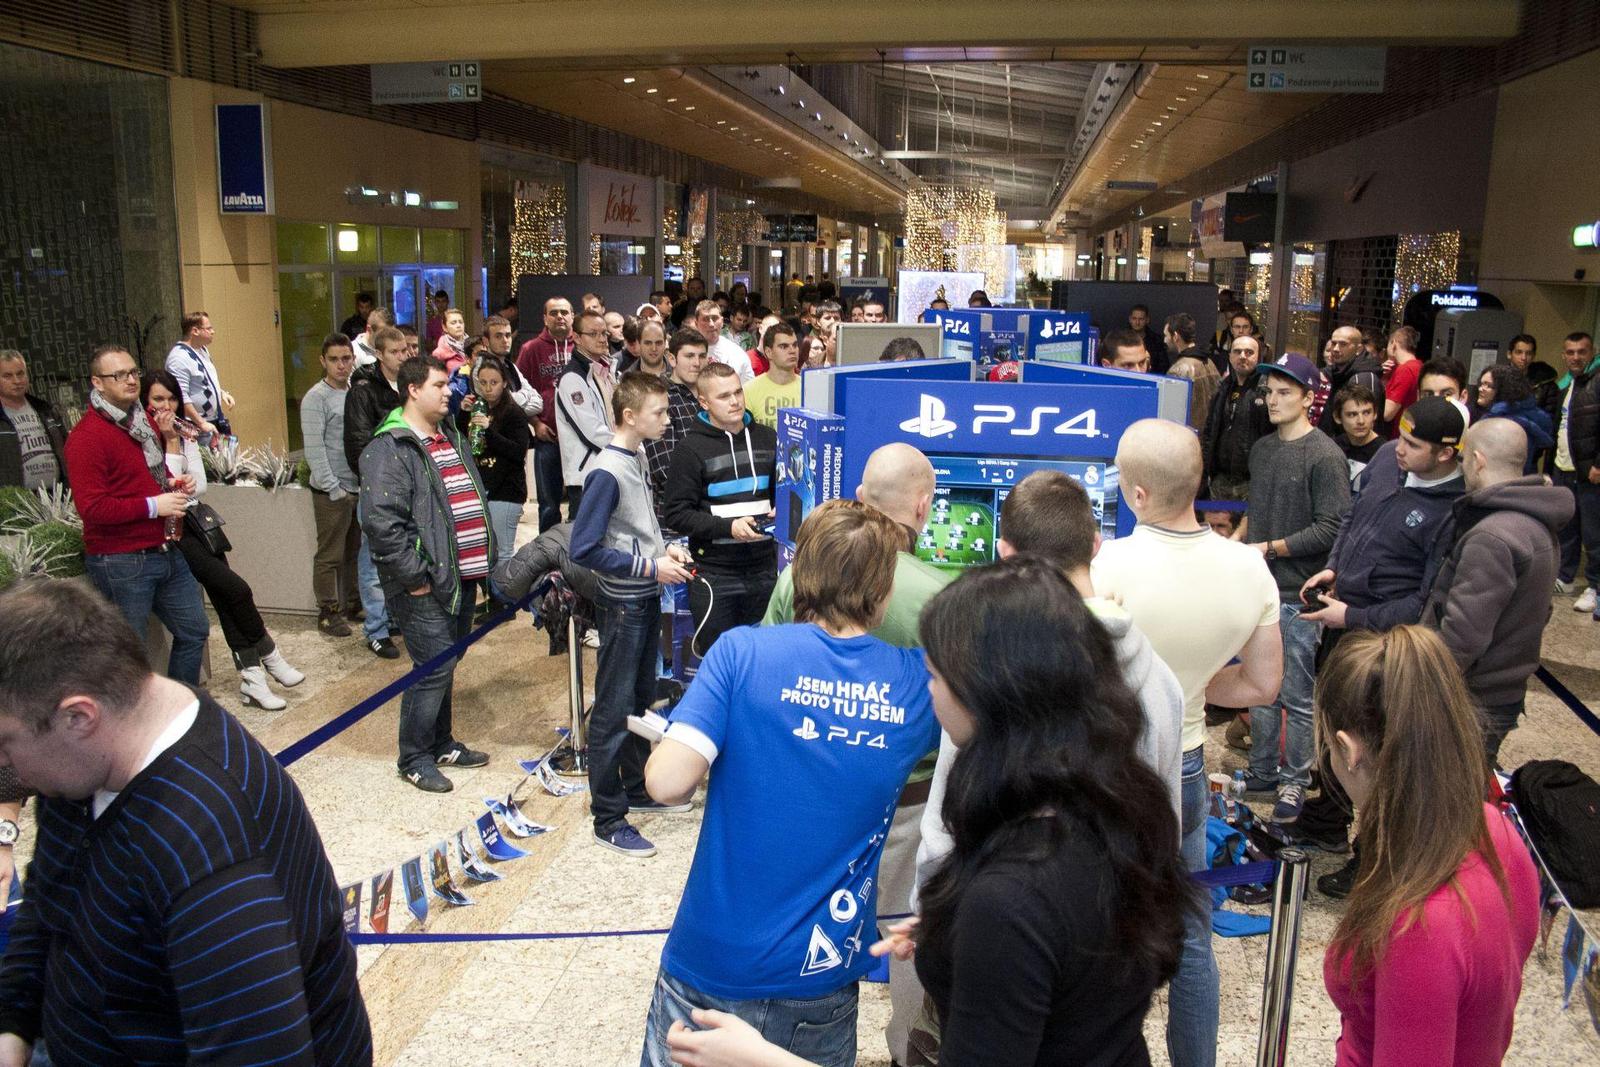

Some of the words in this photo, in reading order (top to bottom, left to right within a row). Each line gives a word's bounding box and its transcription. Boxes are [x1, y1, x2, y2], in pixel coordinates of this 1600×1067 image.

[1289, 53, 1306, 63] WC
[224, 192, 264, 206] LAVAZZA
[1431, 294, 1478, 307] Pokladňa
[945, 319, 971, 335] PS4
[1055, 321, 1081, 336] PS4
[791, 416, 808, 430] PS4
[972, 404, 1101, 438] PS4
[822, 443, 832, 502] PREDOBJEDN
[980, 467, 987, 479] 1
[1005, 468, 1015, 480] 0
[795, 675, 834, 696] JSEM
[836, 679, 891, 704] HRÁČ
[780, 688, 831, 710] PROTO
[831, 697, 858, 718] TU
[860, 703, 906, 725] JSEM
[827, 725, 889, 750] PS4
